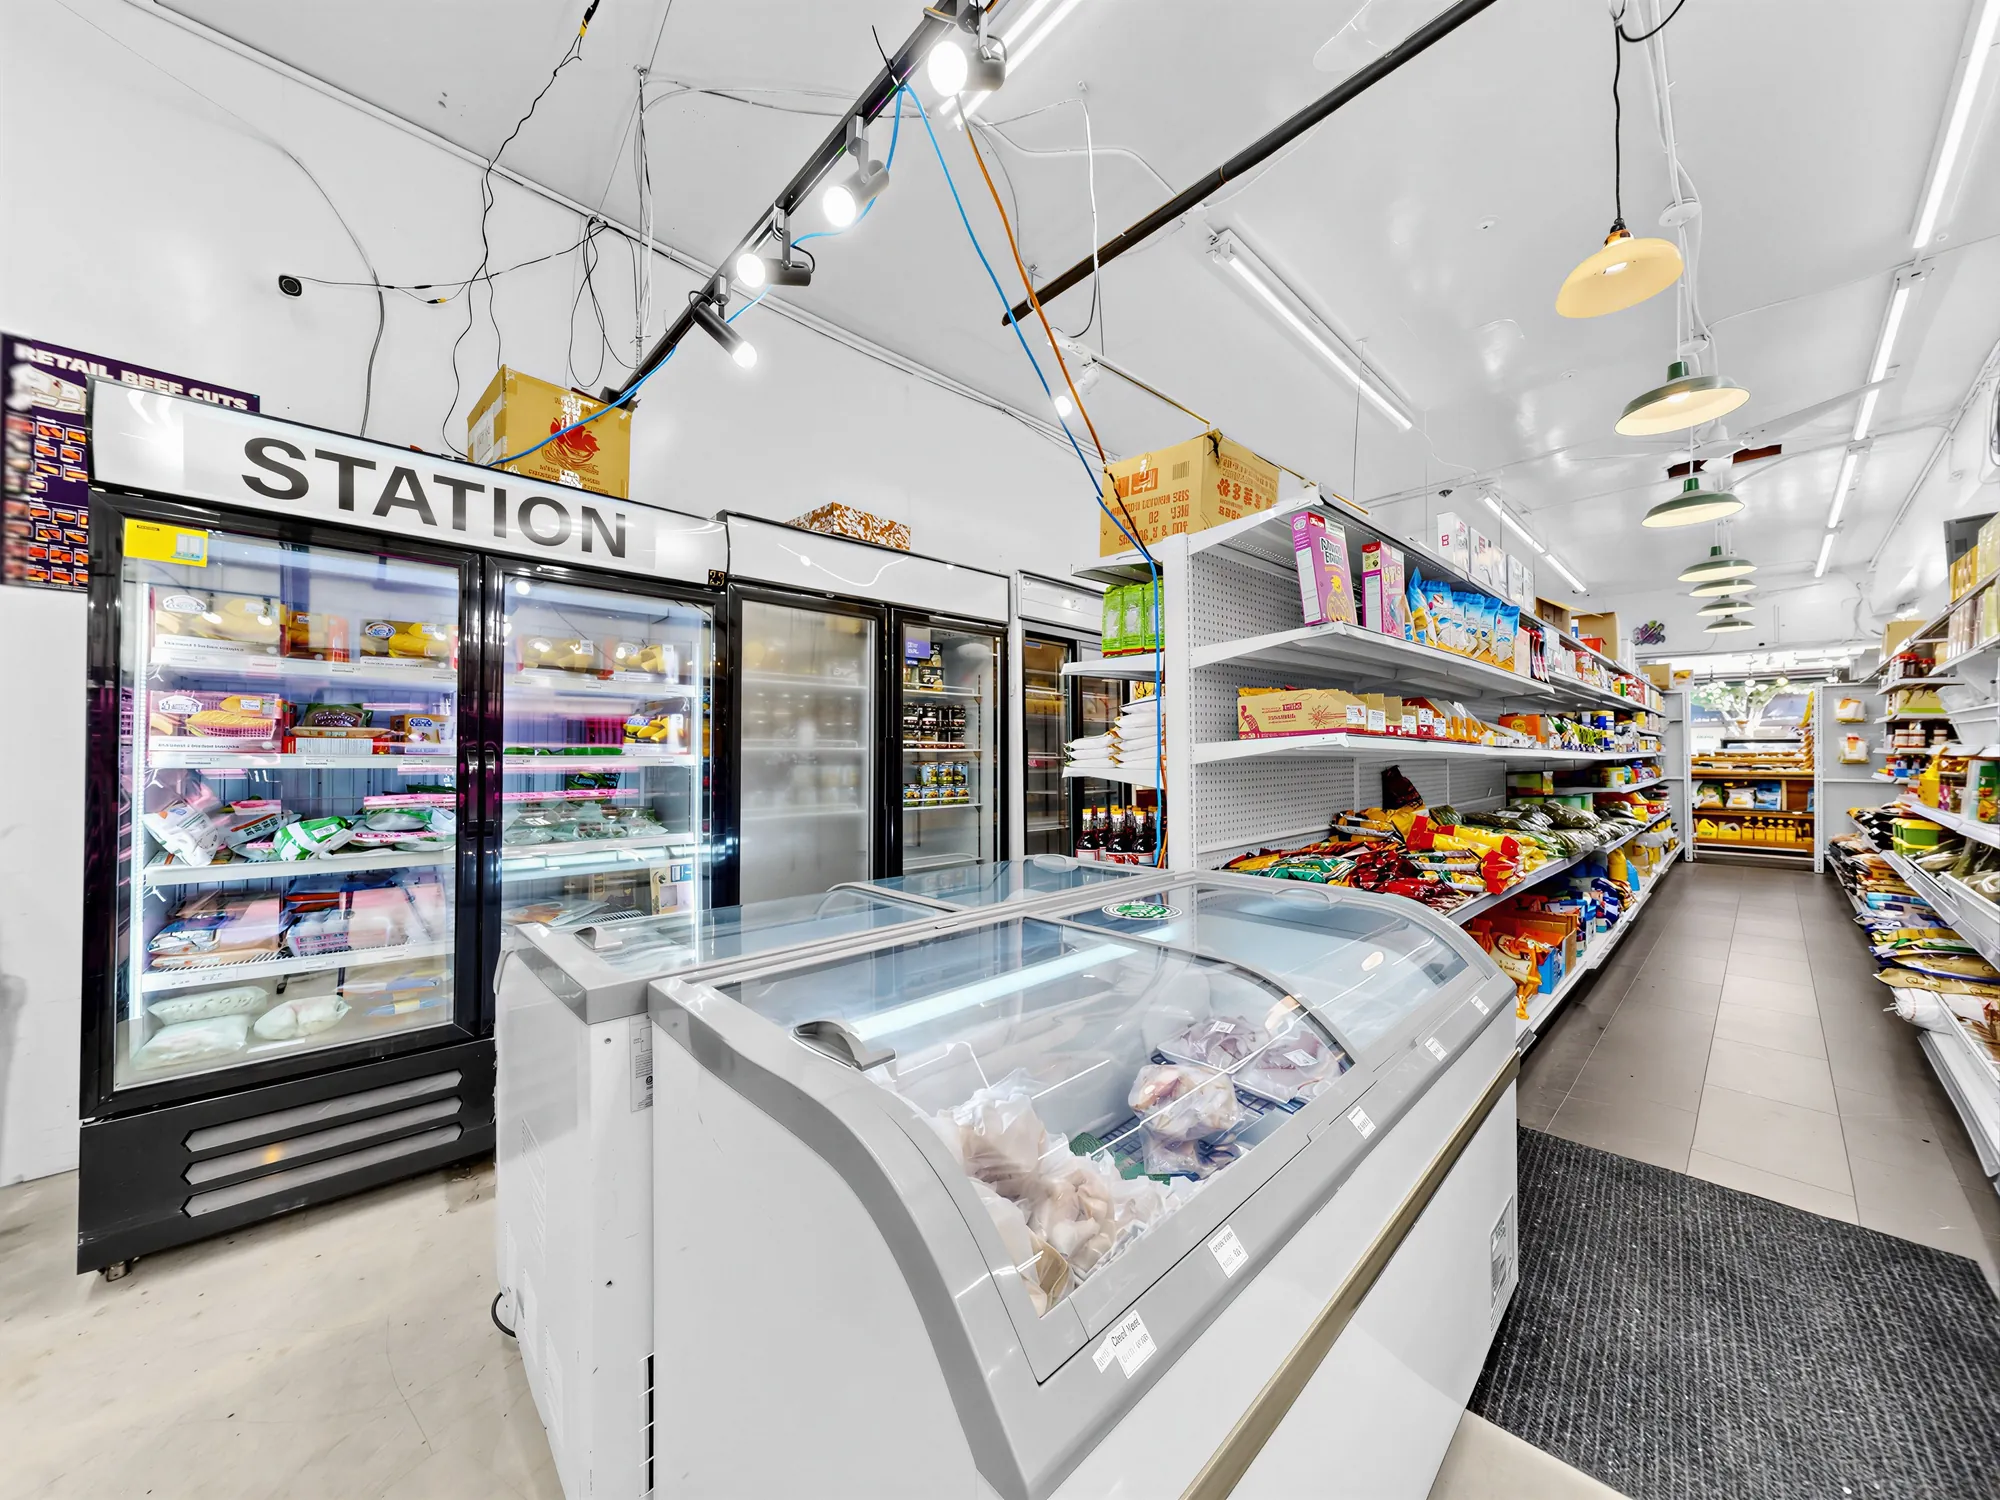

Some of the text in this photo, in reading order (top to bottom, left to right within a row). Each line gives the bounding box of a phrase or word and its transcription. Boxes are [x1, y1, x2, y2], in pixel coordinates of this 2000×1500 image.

[13, 342, 248, 411] RETAIL BEEF CUTS
[241, 436, 627, 560] STATION
